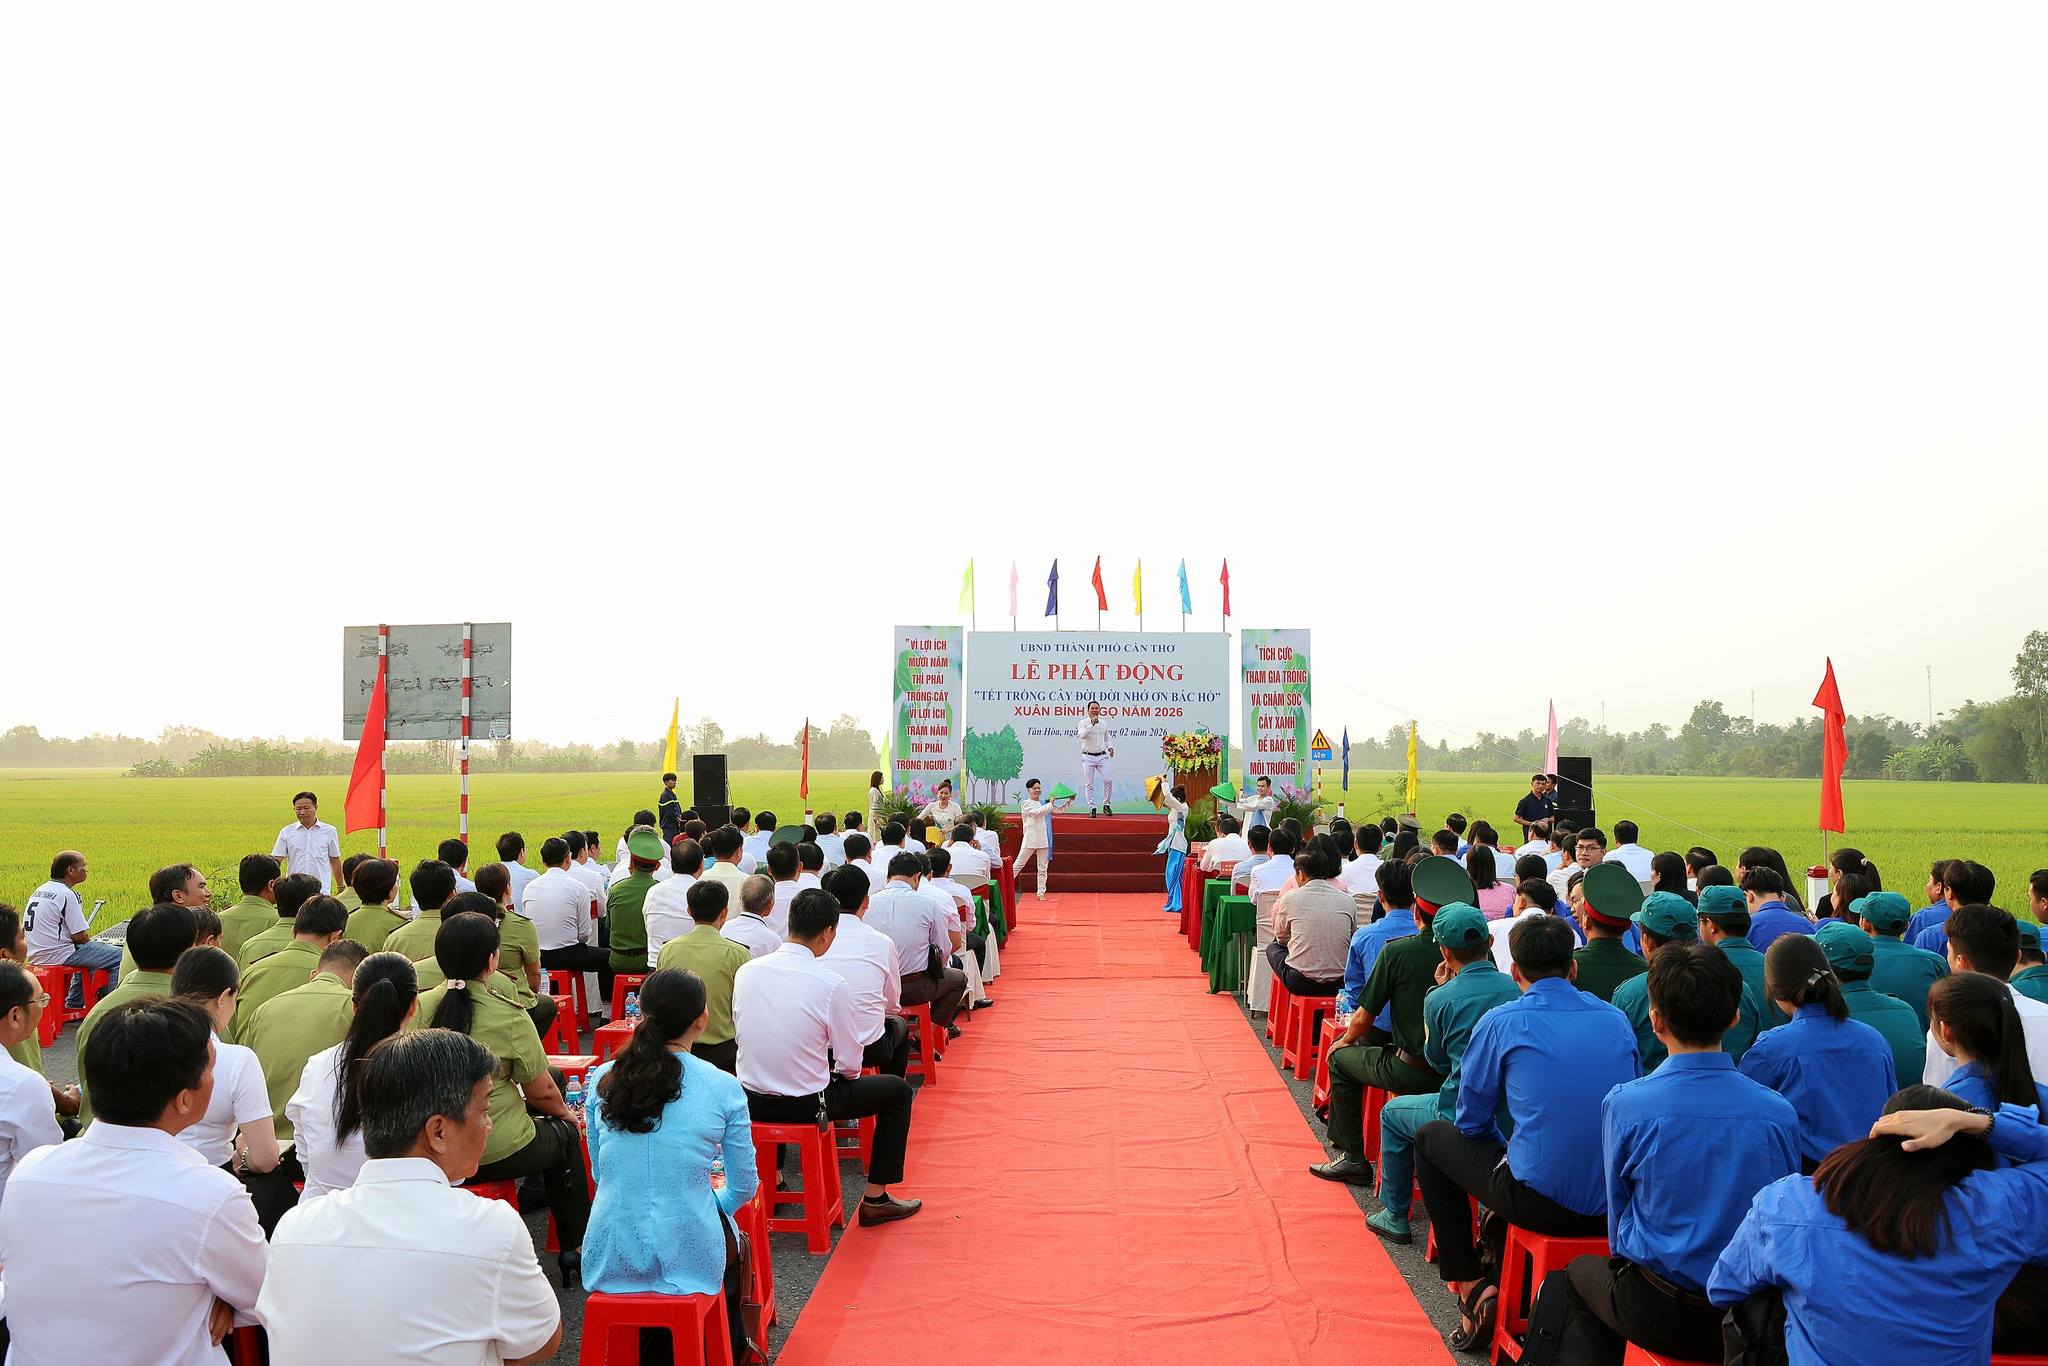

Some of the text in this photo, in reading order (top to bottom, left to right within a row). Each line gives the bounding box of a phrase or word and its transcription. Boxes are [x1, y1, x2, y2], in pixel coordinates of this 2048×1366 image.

[920, 639, 932, 653] LỢI
[933, 638, 947, 650] ÍCH
[1020, 641, 1176, 653] UBND THÀNH PHỐ CẦN THƠ
[908, 655, 948, 667] MƯỜI NĂM
[1277, 646, 1293, 664] CỰC
[912, 671, 944, 684] THÌ PHẢI
[1011, 659, 1184, 685] LỄ PHÁT ĐỘNG
[1246, 665, 1307, 683] THAM GIA TRỒNG
[907, 688, 949, 701] TRỒNG CÂY
[1005, 688, 1046, 701] TRỒNG
[1048, 688, 1073, 701] CÂY
[1075, 688, 1096, 701] ĐỜI
[1099, 689, 1120, 702] ĐỜI
[1124, 689, 1149, 702] NHỚ
[1151, 691, 1168, 702] ƠN
[1171, 689, 1195, 702] BÁC
[1251, 690, 1302, 706] VÀ CHĂM SÓC
[909, 706, 946, 721] VÌ LỢI ÍCH
[1014, 704, 1184, 719] XUÂN BÍNH GỌ NĂM 2026
[1258, 713, 1296, 729] CÂY XANH
[907, 723, 948, 736] TRĂM NĂM
[1027, 727, 1042, 736] Tân
[1044, 727, 1062, 736] Hòa,
[1120, 727, 1129, 737] 02
[1130, 727, 1148, 737] năm
[1149, 727, 1168, 737] 2026
[911, 739, 943, 753] THÌ PHẢI
[1258, 733, 1296, 755] ĐỂ BẢO VỆ
[896, 756, 922, 770] TRỒNG
[923, 757, 947, 770] NGƯỜI
[1249, 759, 1264, 775] MÔI
[1266, 759, 1296, 775] TRƯỜNG
[24, 901, 39, 932] 5
